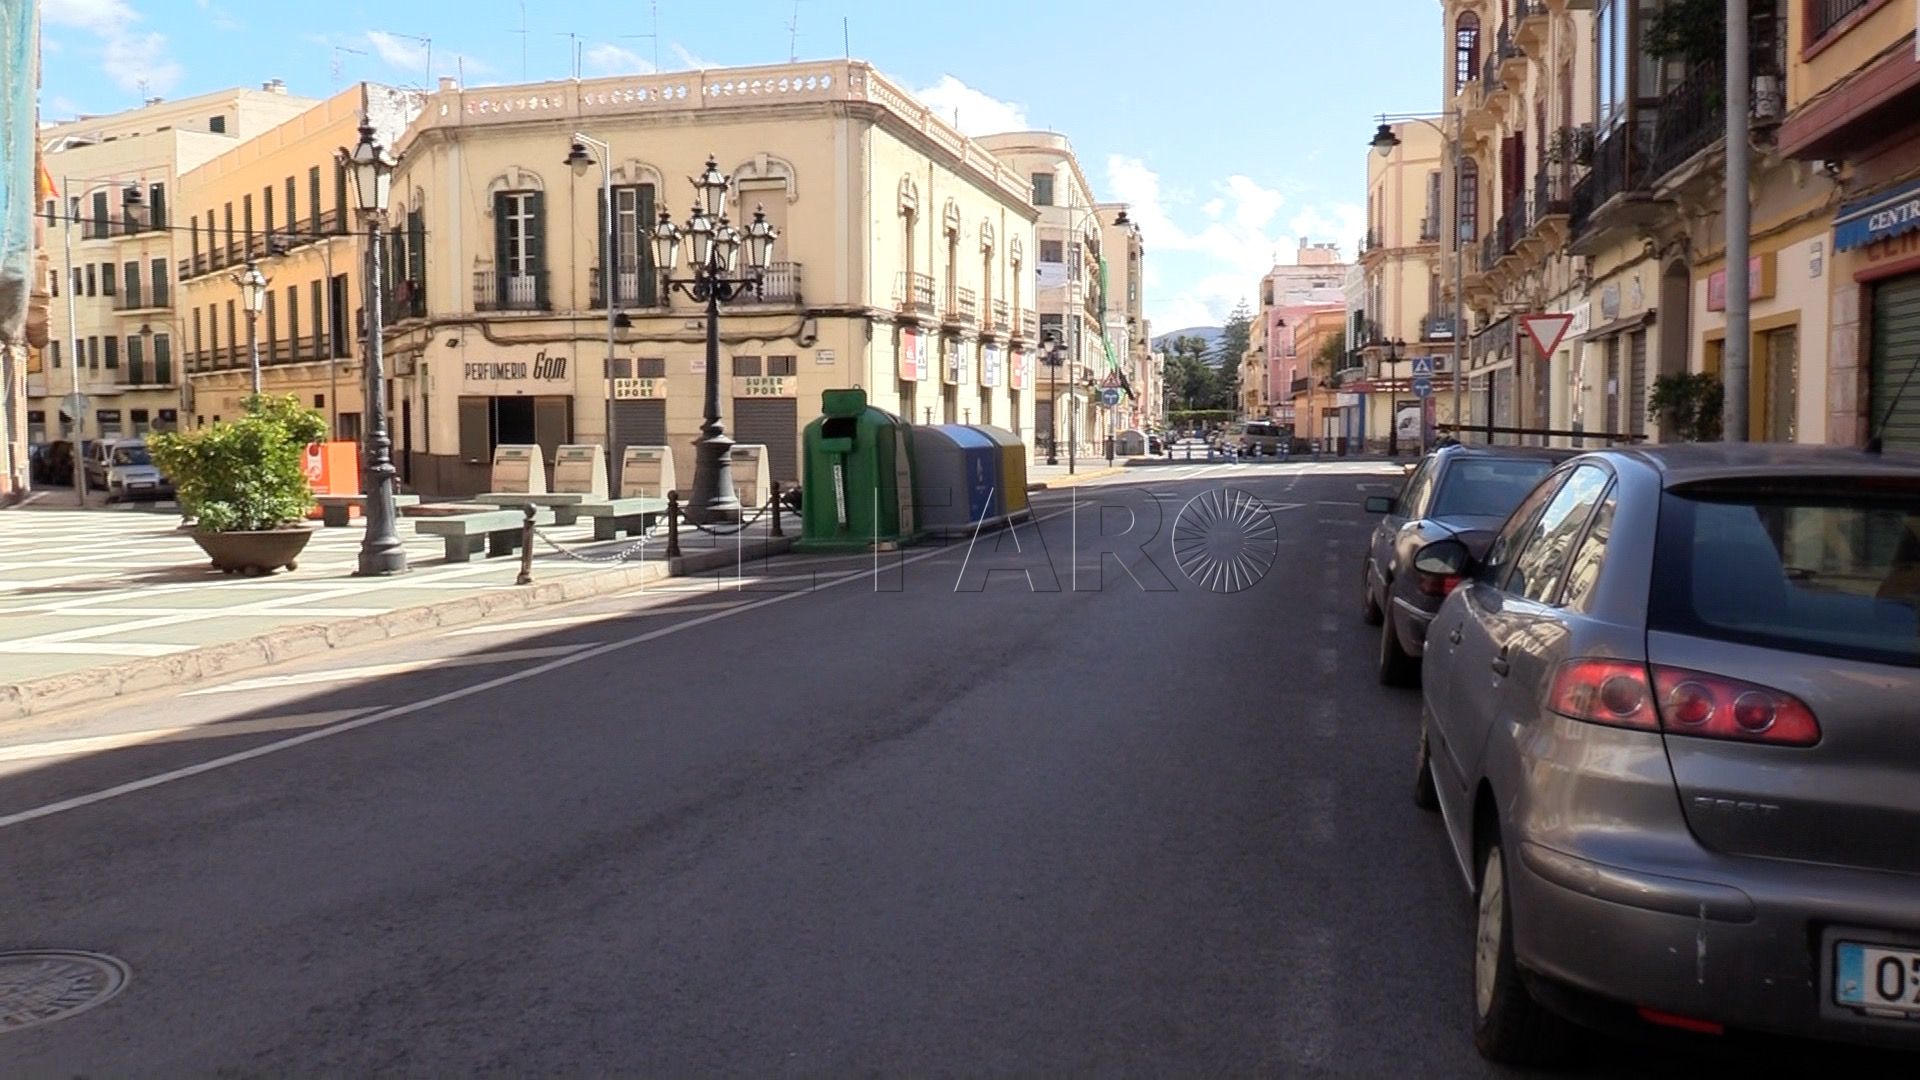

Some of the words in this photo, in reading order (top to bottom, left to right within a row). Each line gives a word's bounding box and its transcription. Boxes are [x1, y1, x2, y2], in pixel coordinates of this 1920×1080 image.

[465, 362, 527, 380] PERFUMERIA
[617, 380, 653, 388] SUPER
[746, 378, 783, 386] SUPER
[617, 389, 653, 397] SPORT
[746, 387, 783, 395] SPORT
